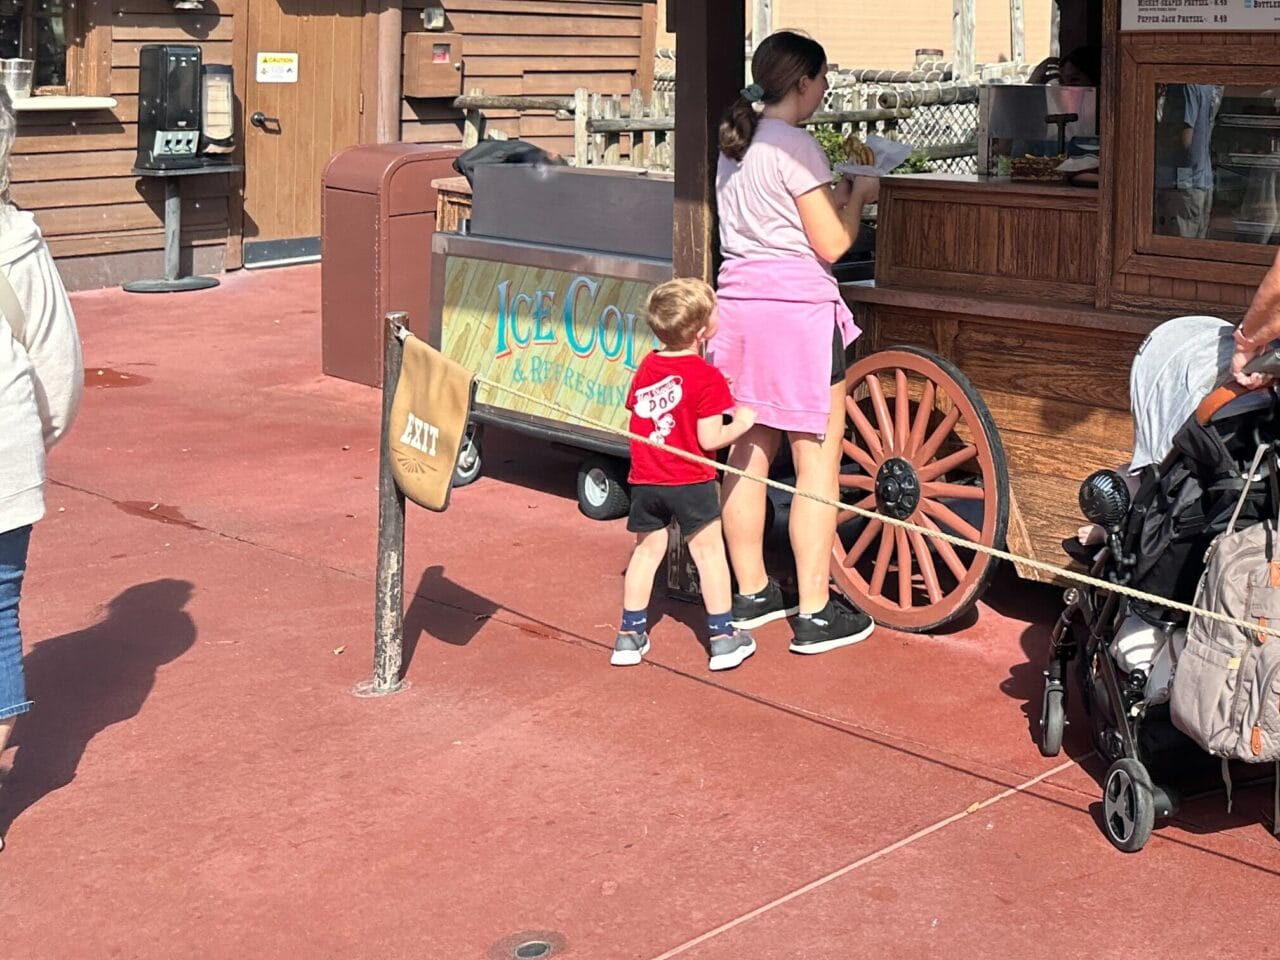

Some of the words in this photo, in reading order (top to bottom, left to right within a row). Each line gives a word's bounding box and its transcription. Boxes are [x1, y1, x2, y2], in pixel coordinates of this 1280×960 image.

[496, 279, 557, 358] ICE
[563, 276, 659, 372] COL
[512, 358, 526, 383] &
[530, 355, 627, 407] REFRESHIN
[649, 390, 675, 413] DOG
[400, 412, 440, 457] EXIT
